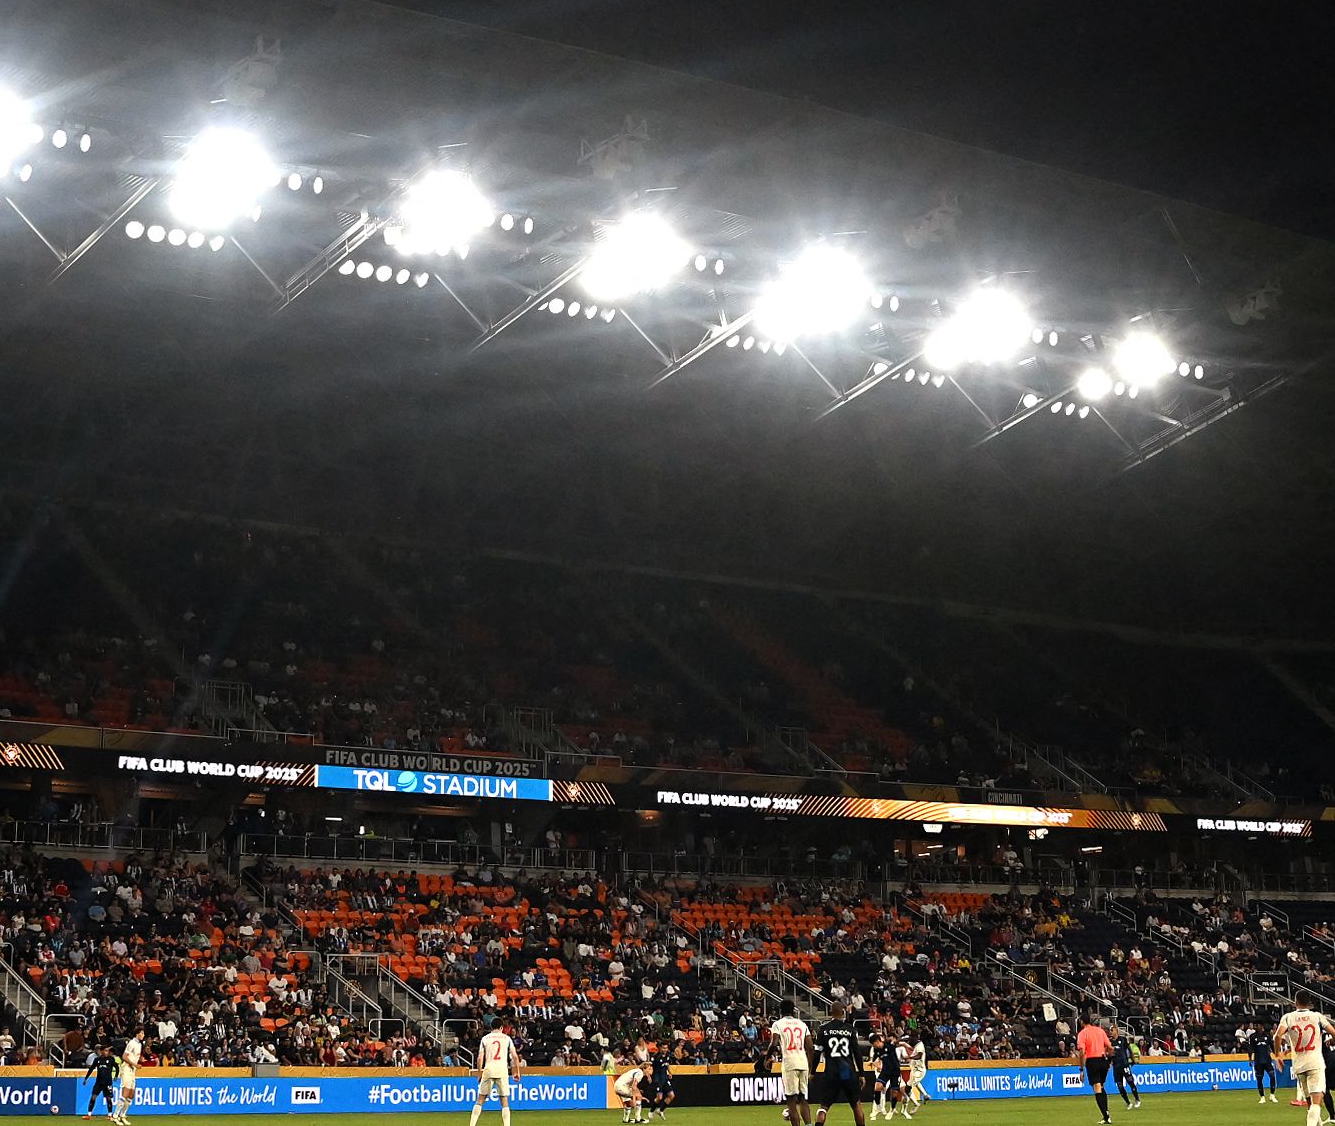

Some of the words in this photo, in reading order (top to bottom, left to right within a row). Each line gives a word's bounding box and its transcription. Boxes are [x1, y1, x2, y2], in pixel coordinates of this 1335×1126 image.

[118, 756, 148, 771] FIFA
[150, 758, 185, 774] CLUB
[187, 760, 235, 777] WORLD
[236, 764, 264, 778] CUP
[326, 750, 358, 766] FIFA
[361, 752, 399, 769] CLUB
[402, 755, 461, 773] WORLD
[463, 760, 492, 775] CUP
[353, 770, 396, 792] TQL
[423, 773, 517, 800] STADIUM
[657, 791, 681, 804] FIFA
[682, 792, 710, 805] CLUB
[710, 794, 749, 808] WORLD
[750, 796, 771, 809] CUP
[1236, 820, 1265, 831] WORLD
[783, 1027, 803, 1051] 23
[828, 1037, 850, 1058] 23
[1291, 1024, 1316, 1053] 22
[492, 1040, 501, 1061] 2
[936, 1076, 979, 1093] FOOTBALL
[981, 1075, 1011, 1092] UNITES
[1013, 1074, 1028, 1091] the
[1028, 1073, 1053, 1091] World
[1065, 1077, 1080, 1085] FIFA
[169, 1086, 213, 1106] UNITES
[217, 1085, 238, 1105] the
[238, 1085, 278, 1106] World
[294, 1090, 316, 1100] FIFA
